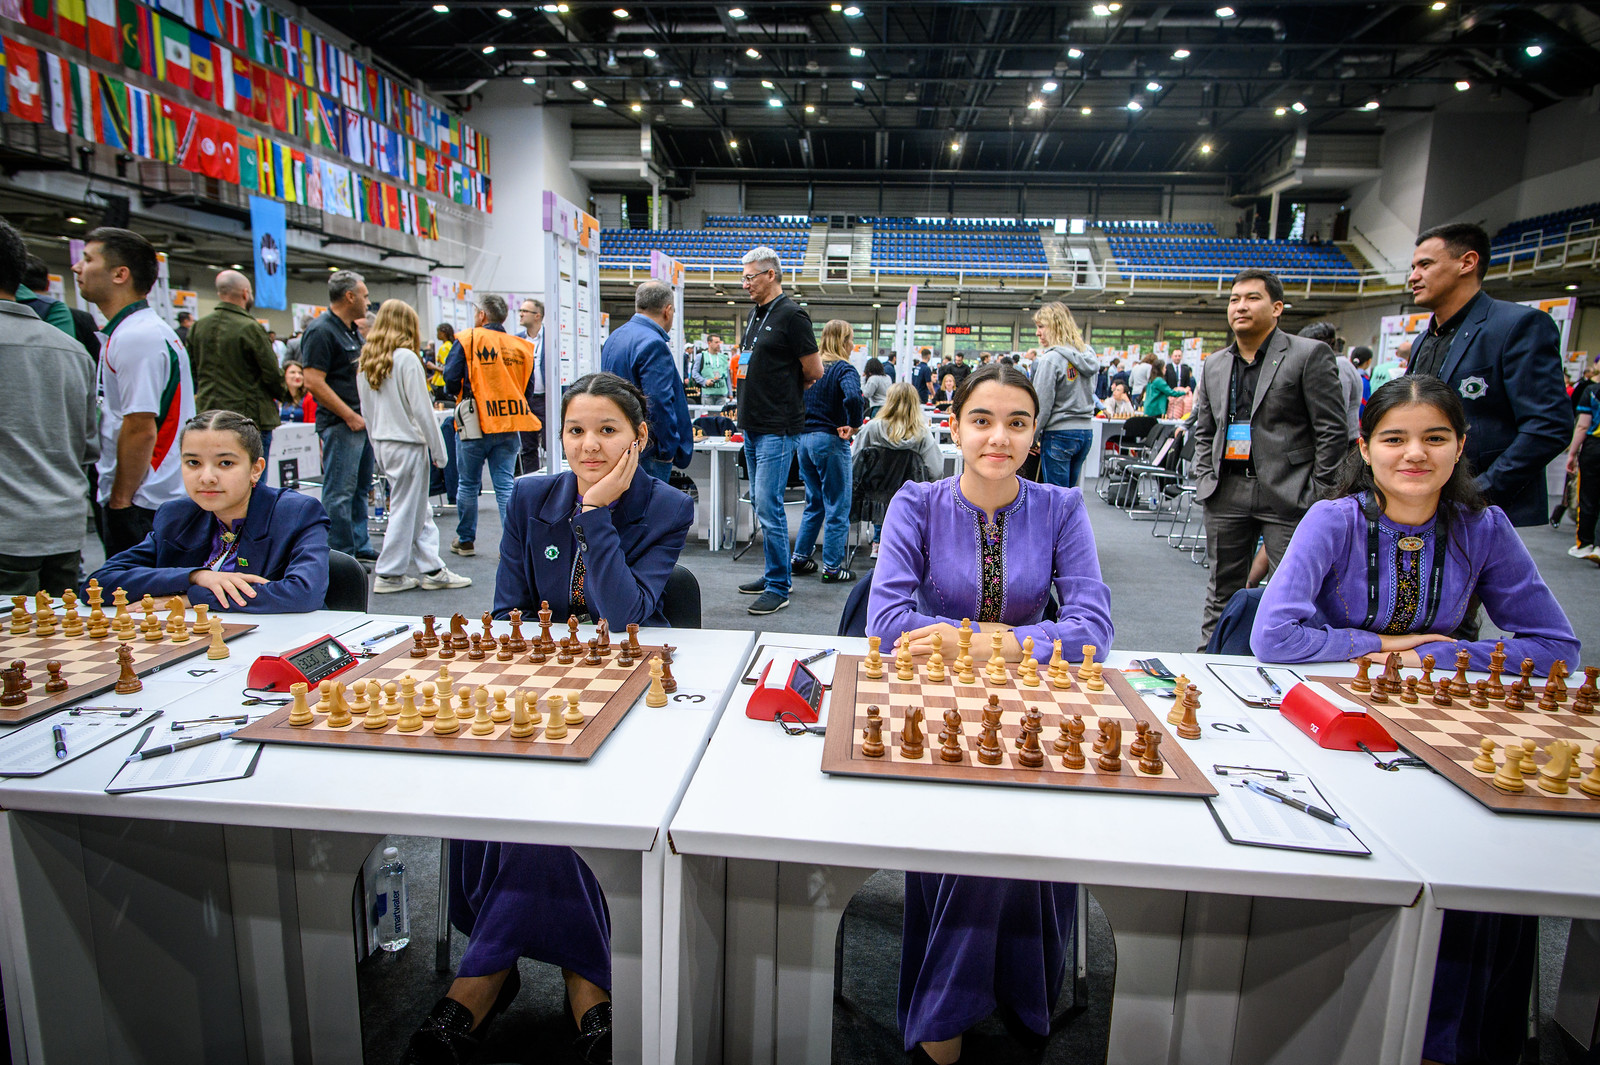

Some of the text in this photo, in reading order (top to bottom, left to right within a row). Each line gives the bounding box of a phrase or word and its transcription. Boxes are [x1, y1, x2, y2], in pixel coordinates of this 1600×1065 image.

[187, 668, 218, 677] 4
[673, 694, 706, 703] 3
[1211, 723, 1250, 733] 2
[392, 890, 402, 934] smartwater
